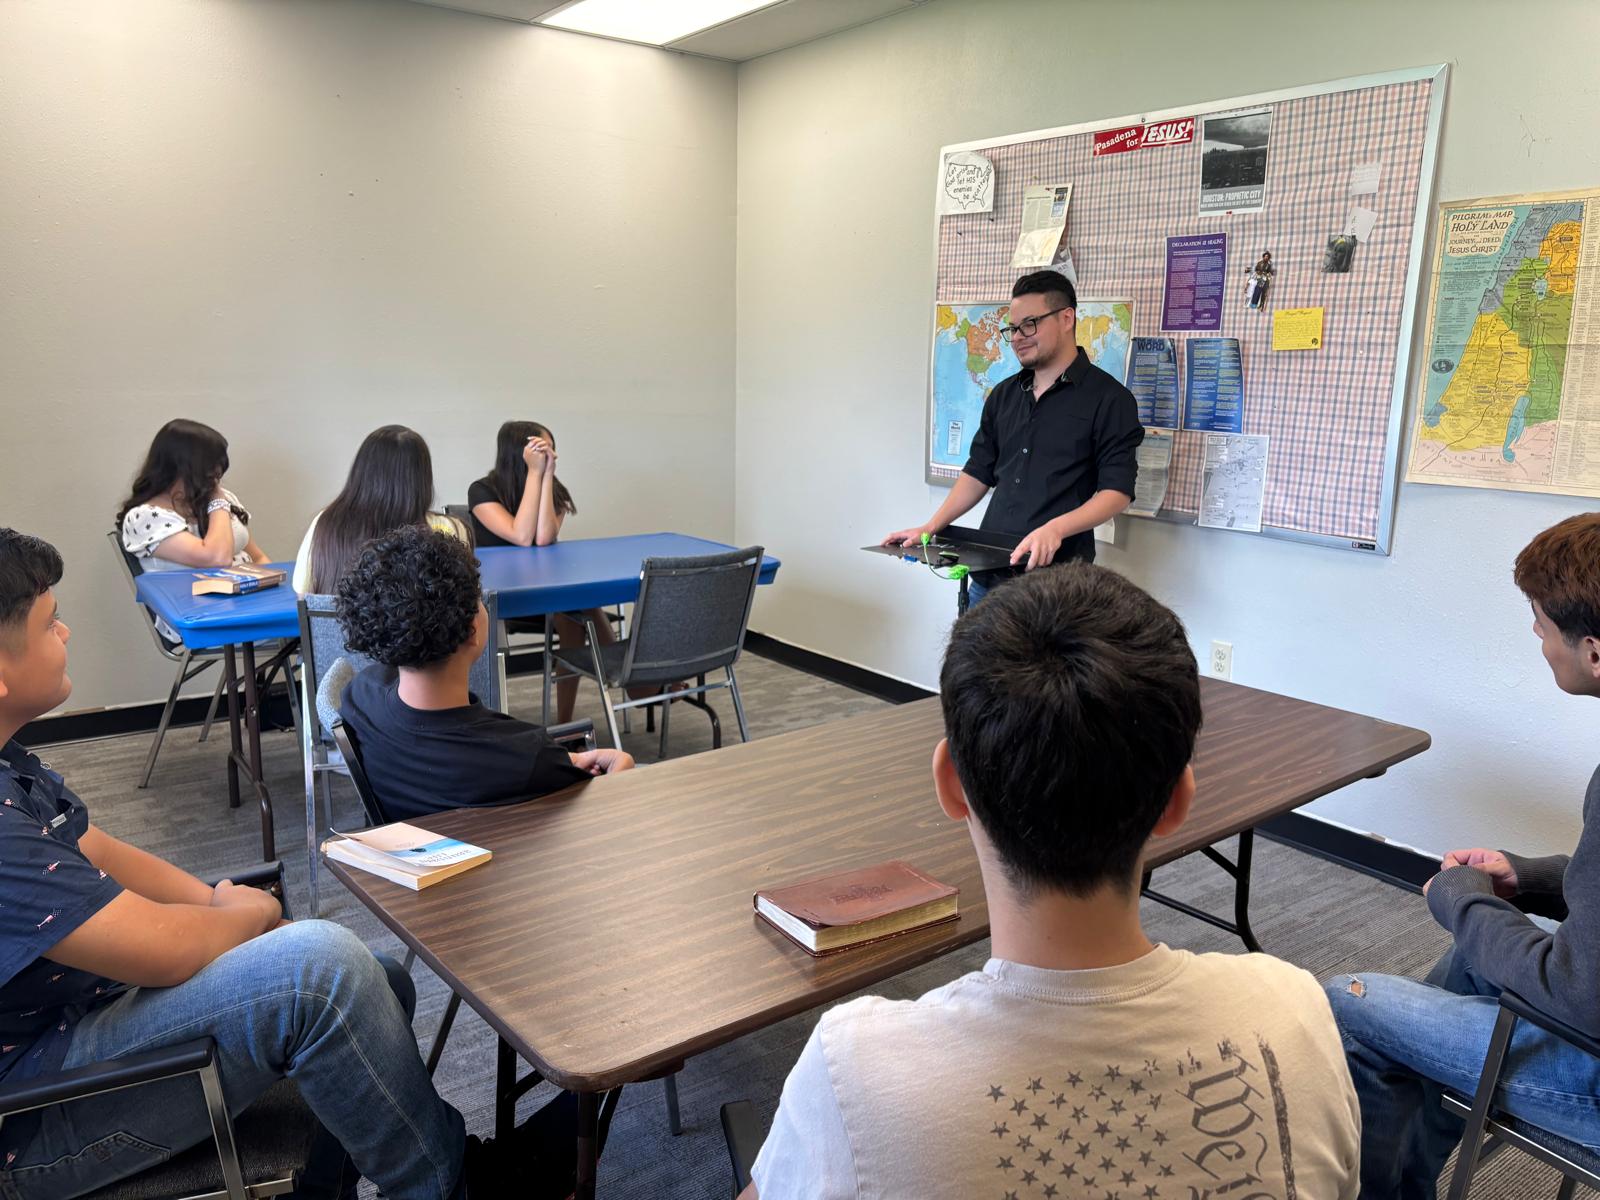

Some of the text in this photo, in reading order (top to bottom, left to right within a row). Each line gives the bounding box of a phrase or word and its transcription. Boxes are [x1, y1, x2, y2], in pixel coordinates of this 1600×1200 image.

[1126, 121, 1192, 148] for JESUS!
[1094, 129, 1137, 155] Pasadena
[1225, 191, 1249, 201] PROPHETIC
[1249, 190, 1261, 199] CITY
[1492, 210, 1513, 218] MAP
[1451, 220, 1478, 232] HOLY
[1480, 219, 1509, 230] LAND
[1470, 244, 1499, 253] CHRIST
[1137, 340, 1165, 351] WORD
